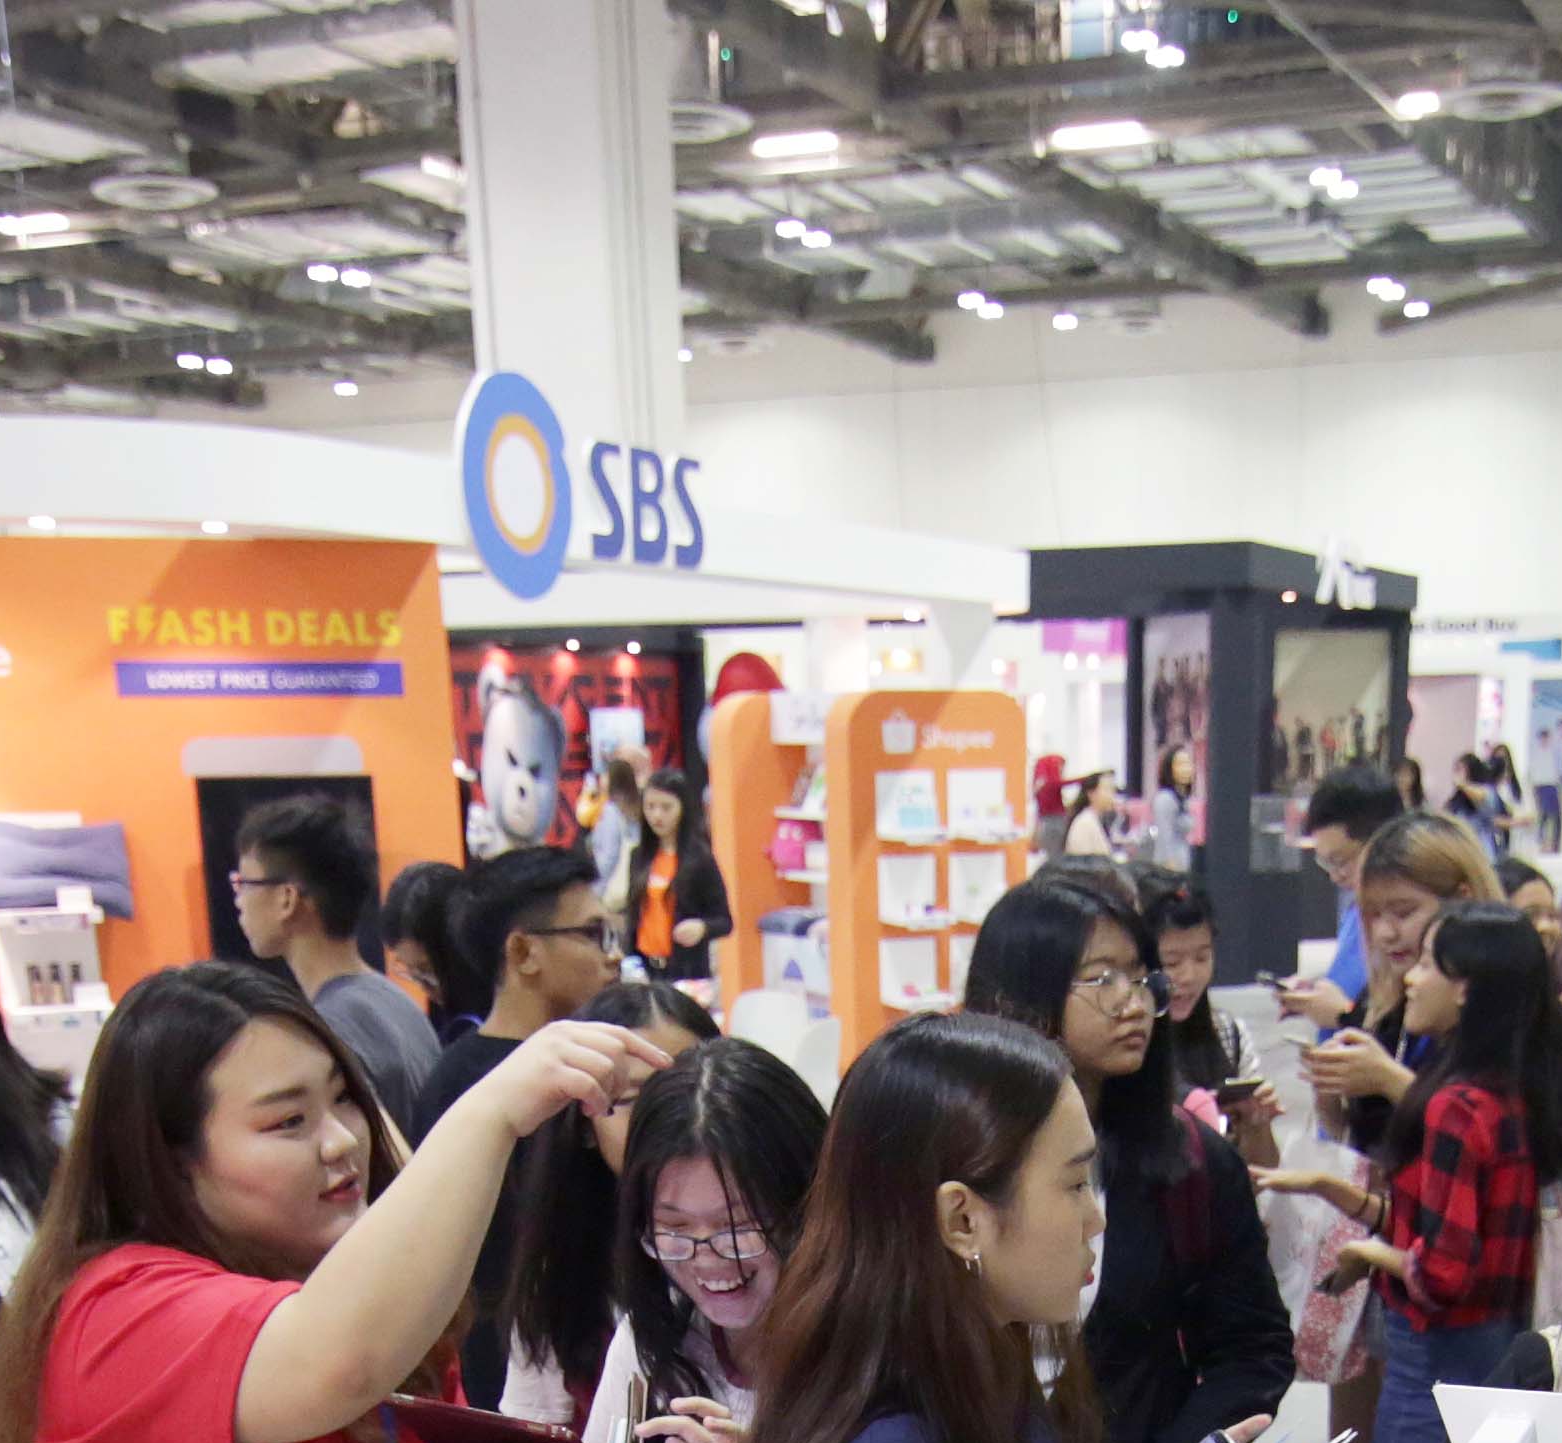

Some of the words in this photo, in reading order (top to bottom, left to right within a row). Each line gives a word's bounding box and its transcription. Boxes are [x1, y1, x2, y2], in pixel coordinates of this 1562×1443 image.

[589, 440, 705, 570] SBS
[265, 608, 405, 647] DEALS
[145, 669, 216, 690] LOWEST
[219, 670, 269, 690] PRICE
